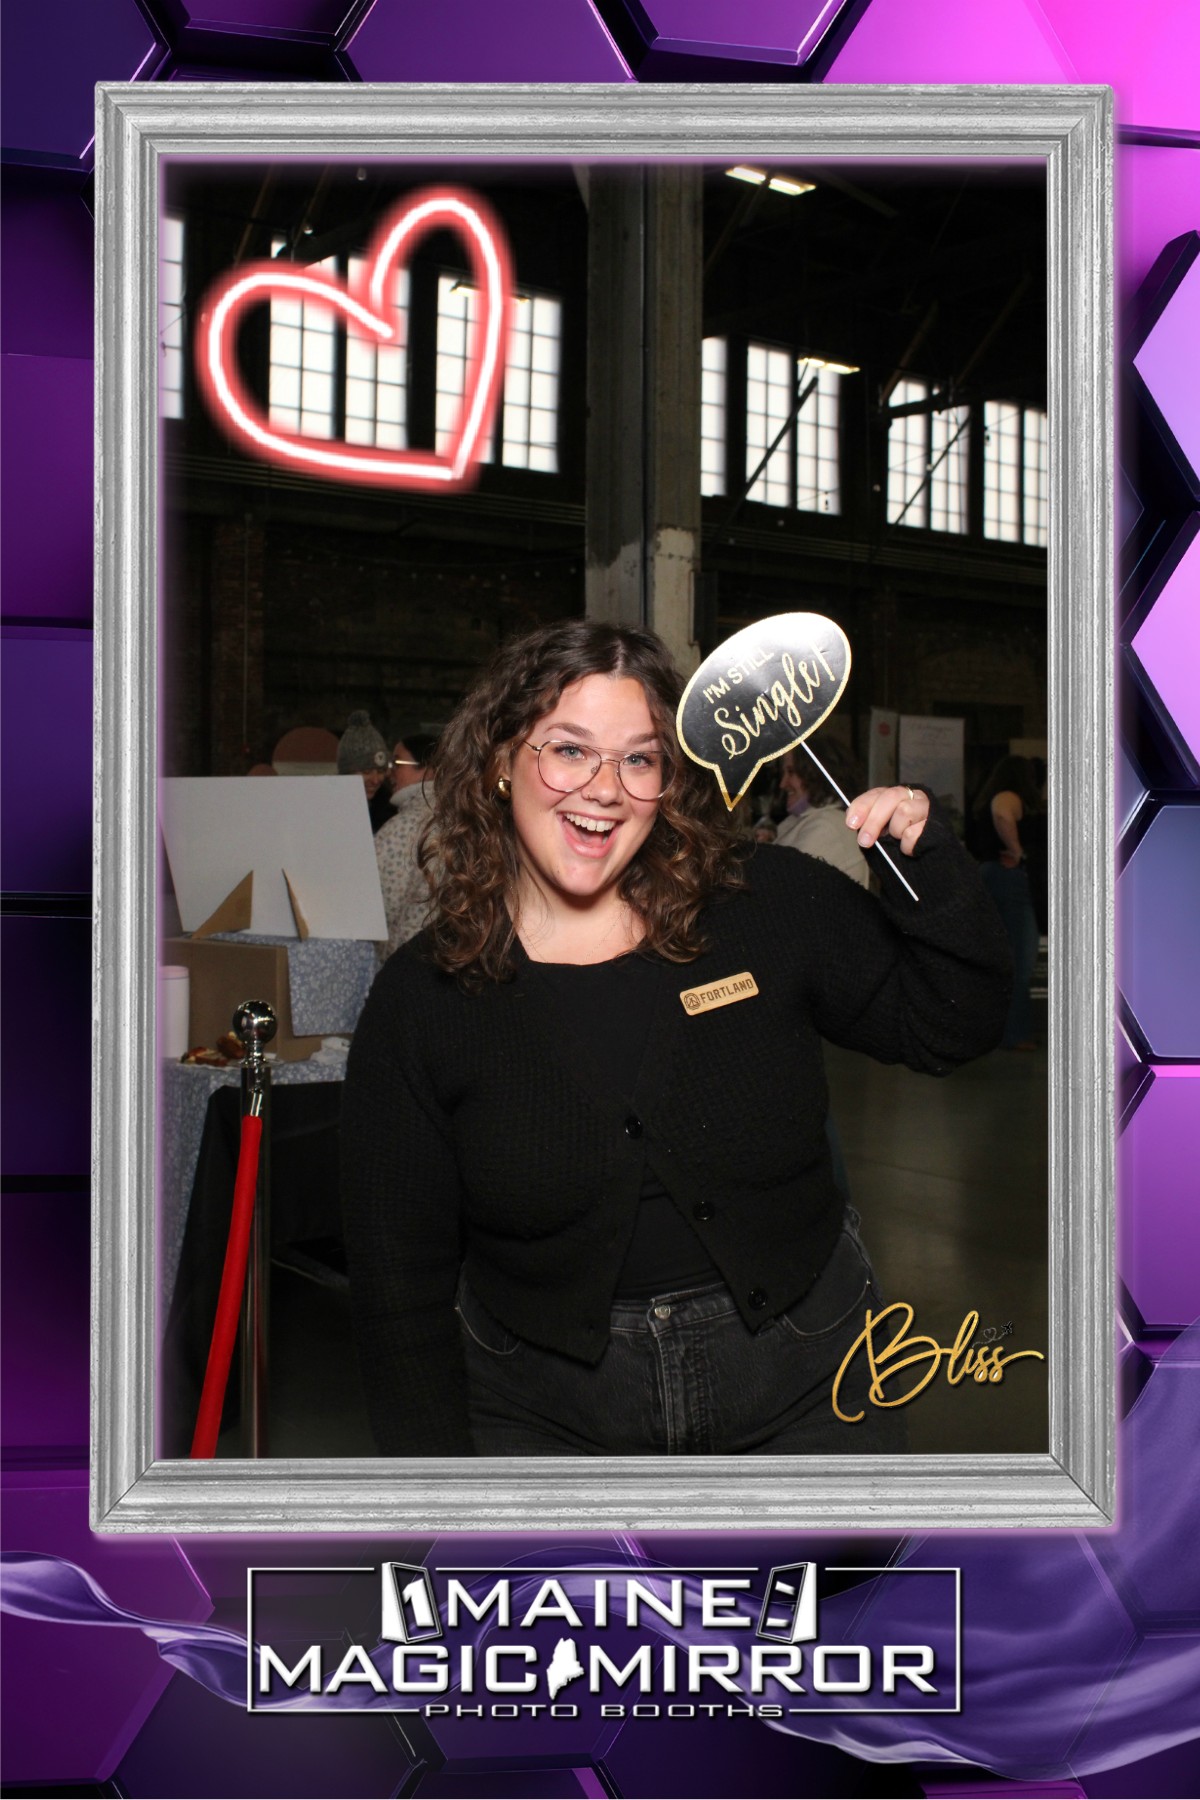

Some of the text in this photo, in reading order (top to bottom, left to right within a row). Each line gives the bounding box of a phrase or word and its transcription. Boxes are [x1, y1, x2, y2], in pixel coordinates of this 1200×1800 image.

[703, 647, 775, 704] I'M STILL
[699, 978, 754, 1004] FORTLAND
